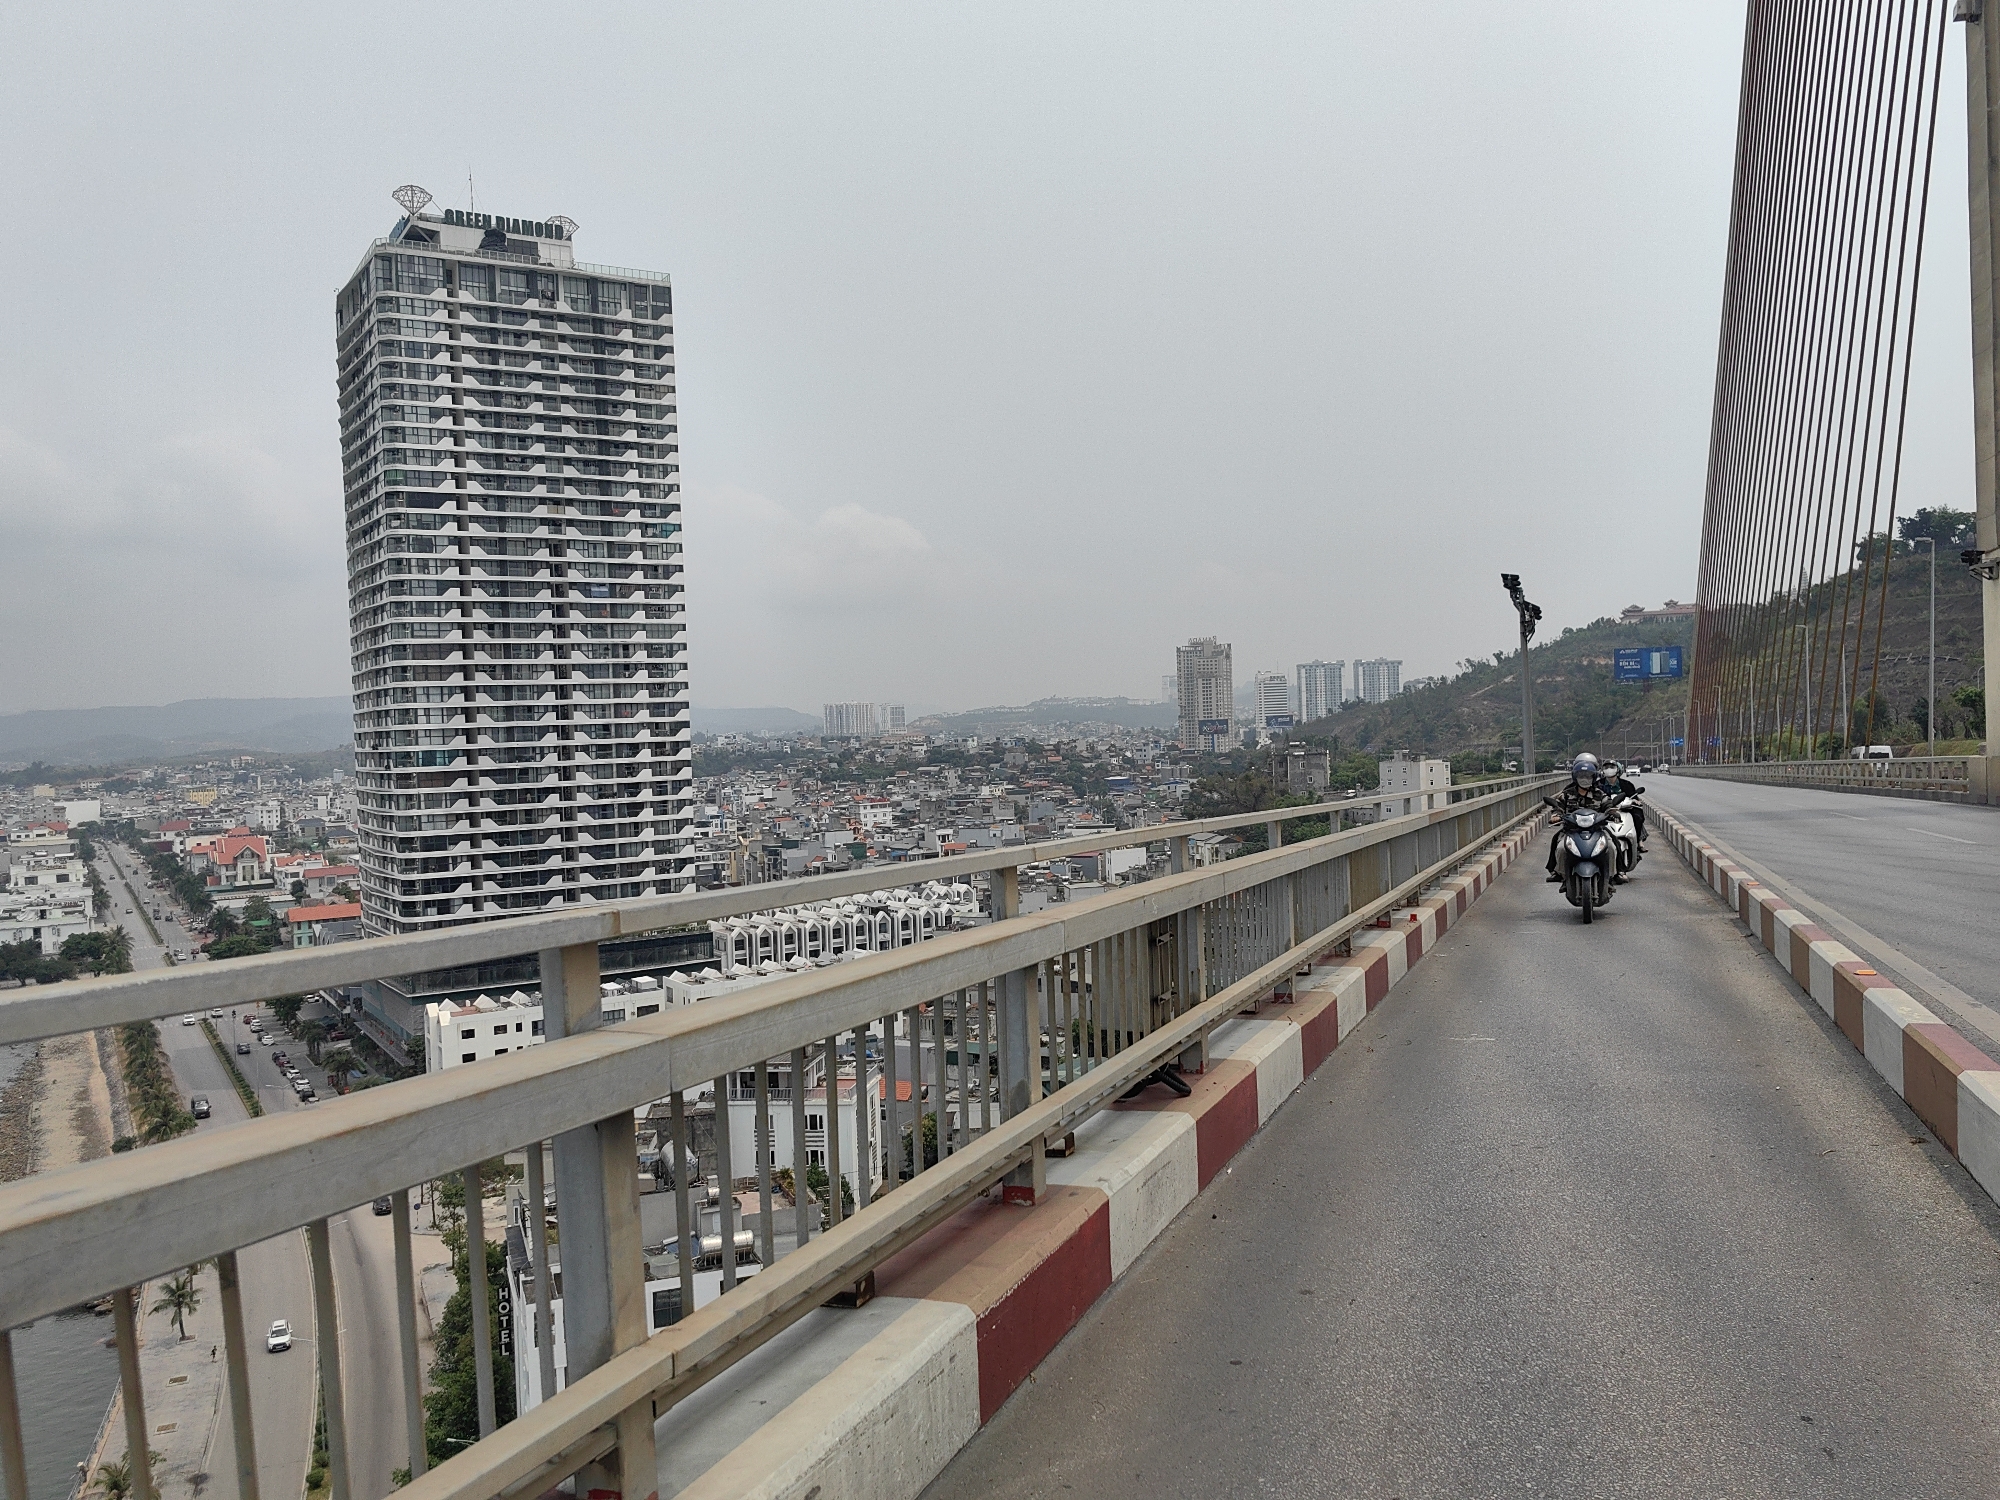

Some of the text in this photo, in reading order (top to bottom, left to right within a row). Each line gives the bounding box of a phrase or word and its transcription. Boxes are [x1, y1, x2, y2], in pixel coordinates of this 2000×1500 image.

[445, 208, 564, 240] GREEN DIAMOND
[498, 1287, 510, 1356] HOTEL
